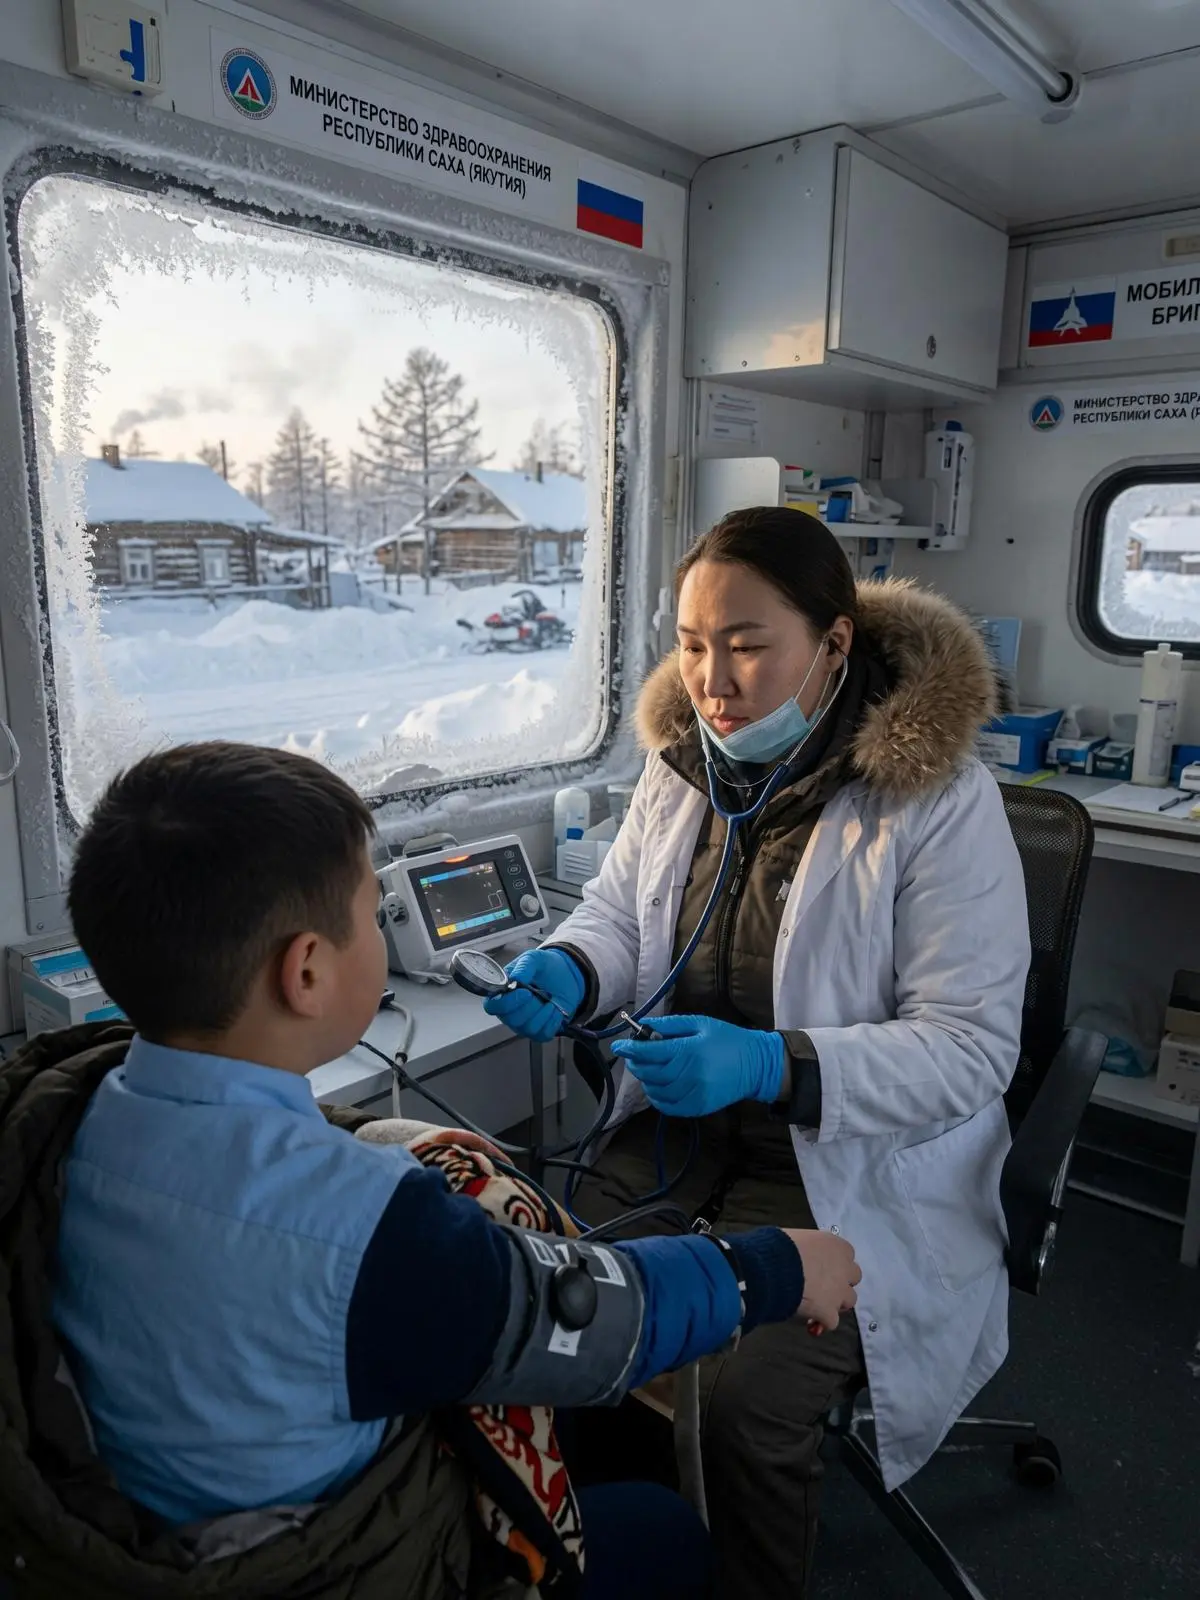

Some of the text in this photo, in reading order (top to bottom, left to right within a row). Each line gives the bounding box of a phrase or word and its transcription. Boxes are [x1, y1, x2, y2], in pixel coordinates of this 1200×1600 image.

[289, 75, 418, 136] МИНИСТЕРСТВО
[422, 122, 551, 182] ЗДРАВООХРАНЕНИЯ
[322, 113, 526, 200] РЕСПУБЛИКИ САХА (ЯКУТИЯ)
[1127, 277, 1200, 302] МОБИЛ
[1074, 393, 1170, 409] МИНИСТЕРСТВО
[1073, 410, 1151, 424] РЕСПУБЛИКИ
[1154, 408, 1187, 420] САХА
